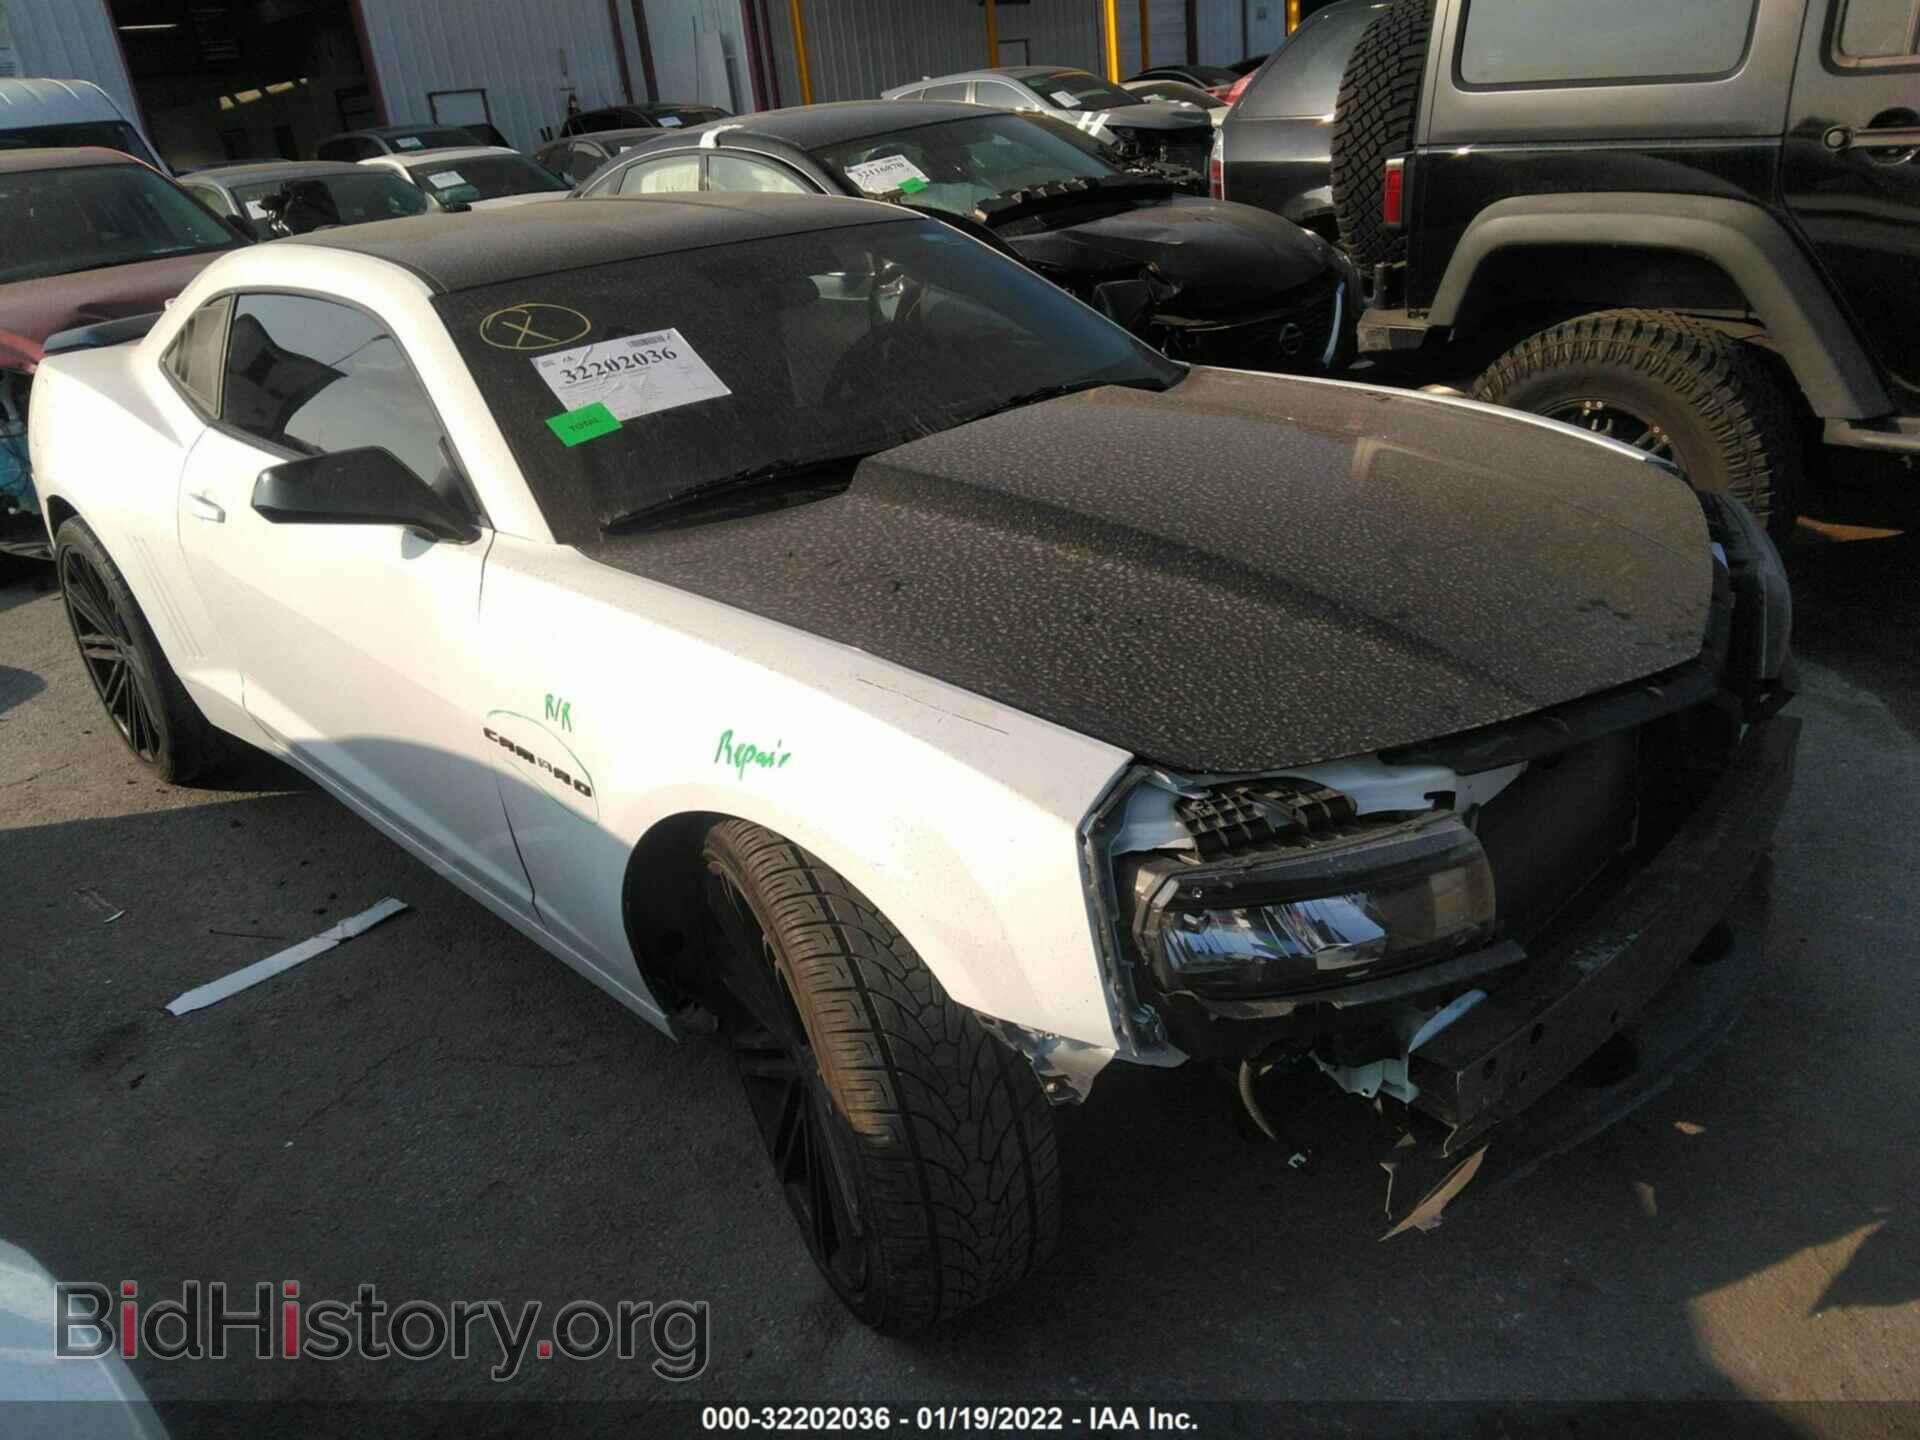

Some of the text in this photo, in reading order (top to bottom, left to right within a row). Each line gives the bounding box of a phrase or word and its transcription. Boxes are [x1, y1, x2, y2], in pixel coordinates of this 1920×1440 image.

[560, 347, 677, 384] 32202036
[545, 693, 572, 732] R/R
[714, 729, 791, 780] Repair
